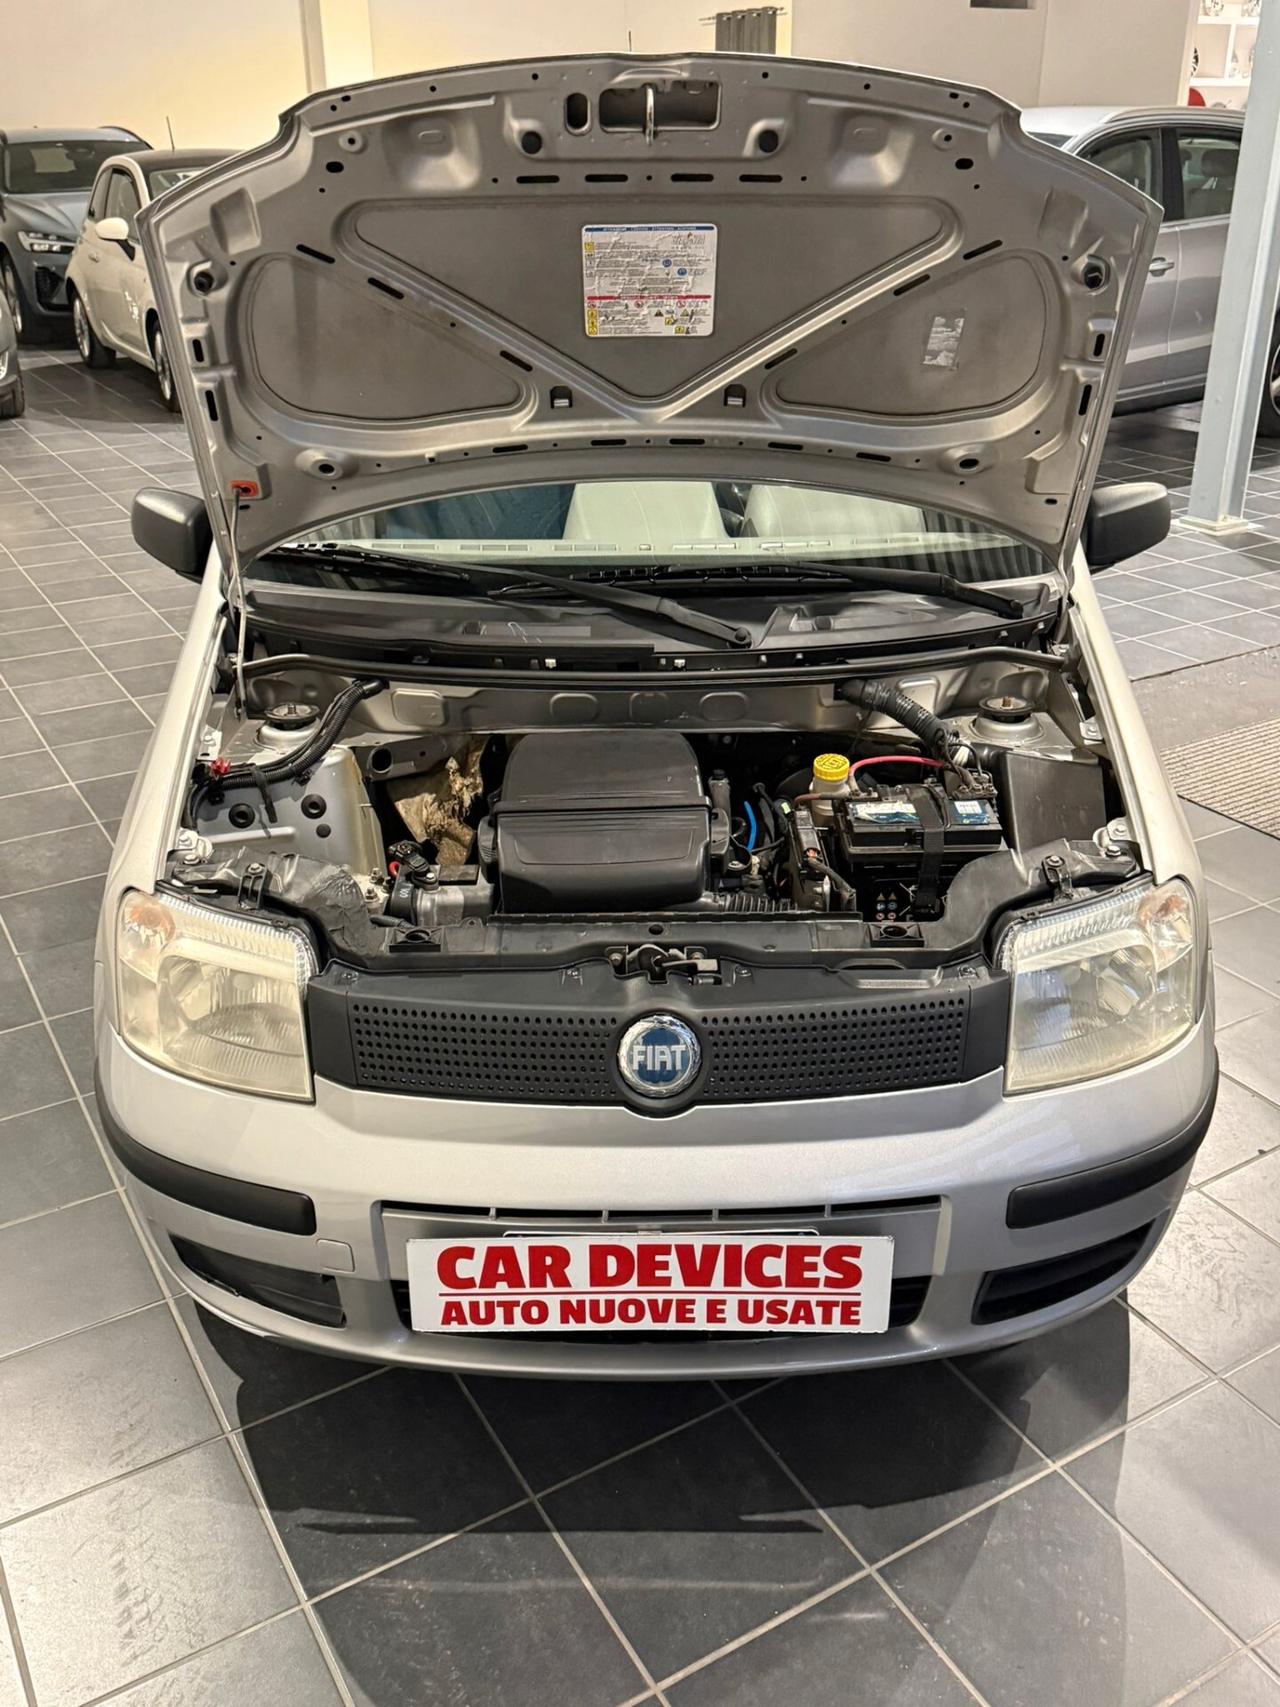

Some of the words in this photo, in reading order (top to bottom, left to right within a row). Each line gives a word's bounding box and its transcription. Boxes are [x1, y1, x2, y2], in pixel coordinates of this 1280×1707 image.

[632, 1045, 686, 1071] FIAT
[437, 1246, 571, 1289] CAR
[589, 1244, 862, 1289] DEVICES
[442, 1300, 548, 1325] AUTO
[560, 1299, 696, 1324] NUOVE
[706, 1299, 727, 1323] E
[738, 1300, 861, 1325] USATE
